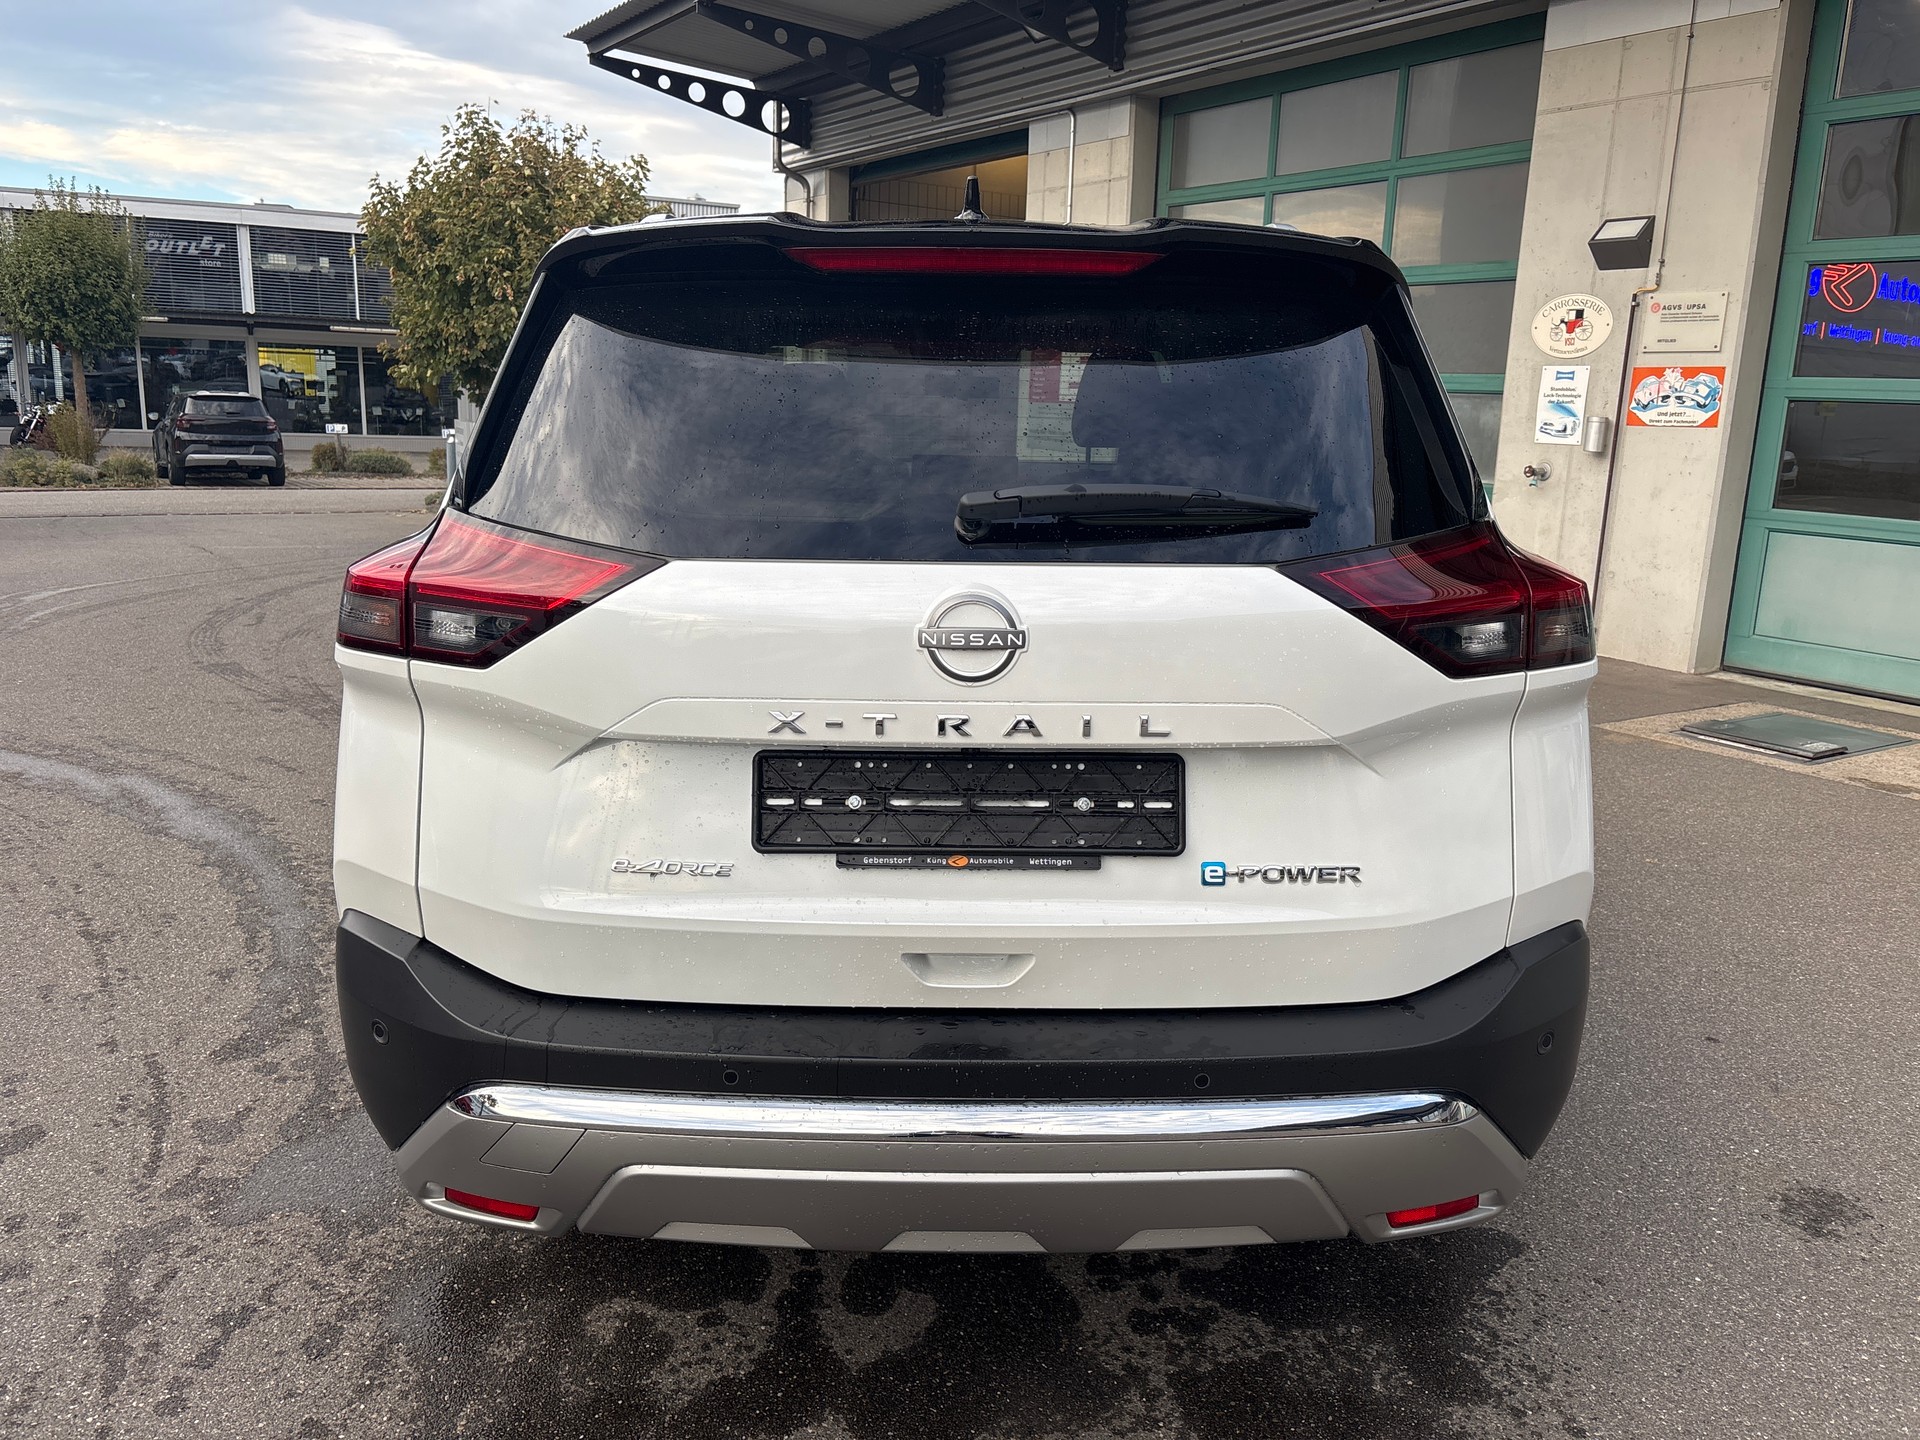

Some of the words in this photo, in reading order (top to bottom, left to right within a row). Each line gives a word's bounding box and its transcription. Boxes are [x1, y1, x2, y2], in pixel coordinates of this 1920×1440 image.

[146, 236, 226, 256] OUTLET
[200, 258, 221, 267] store
[1542, 298, 1605, 318] CARROSSERIE
[921, 631, 1025, 647] NISSAN
[768, 710, 1171, 739] X-TRAIL
[863, 856, 912, 865] Gebenstorf
[926, 856, 947, 867] Küng
[969, 857, 1014, 866] Automobile
[1029, 858, 1073, 867] Wettingen
[1202, 862, 1363, 886] e-POWER
